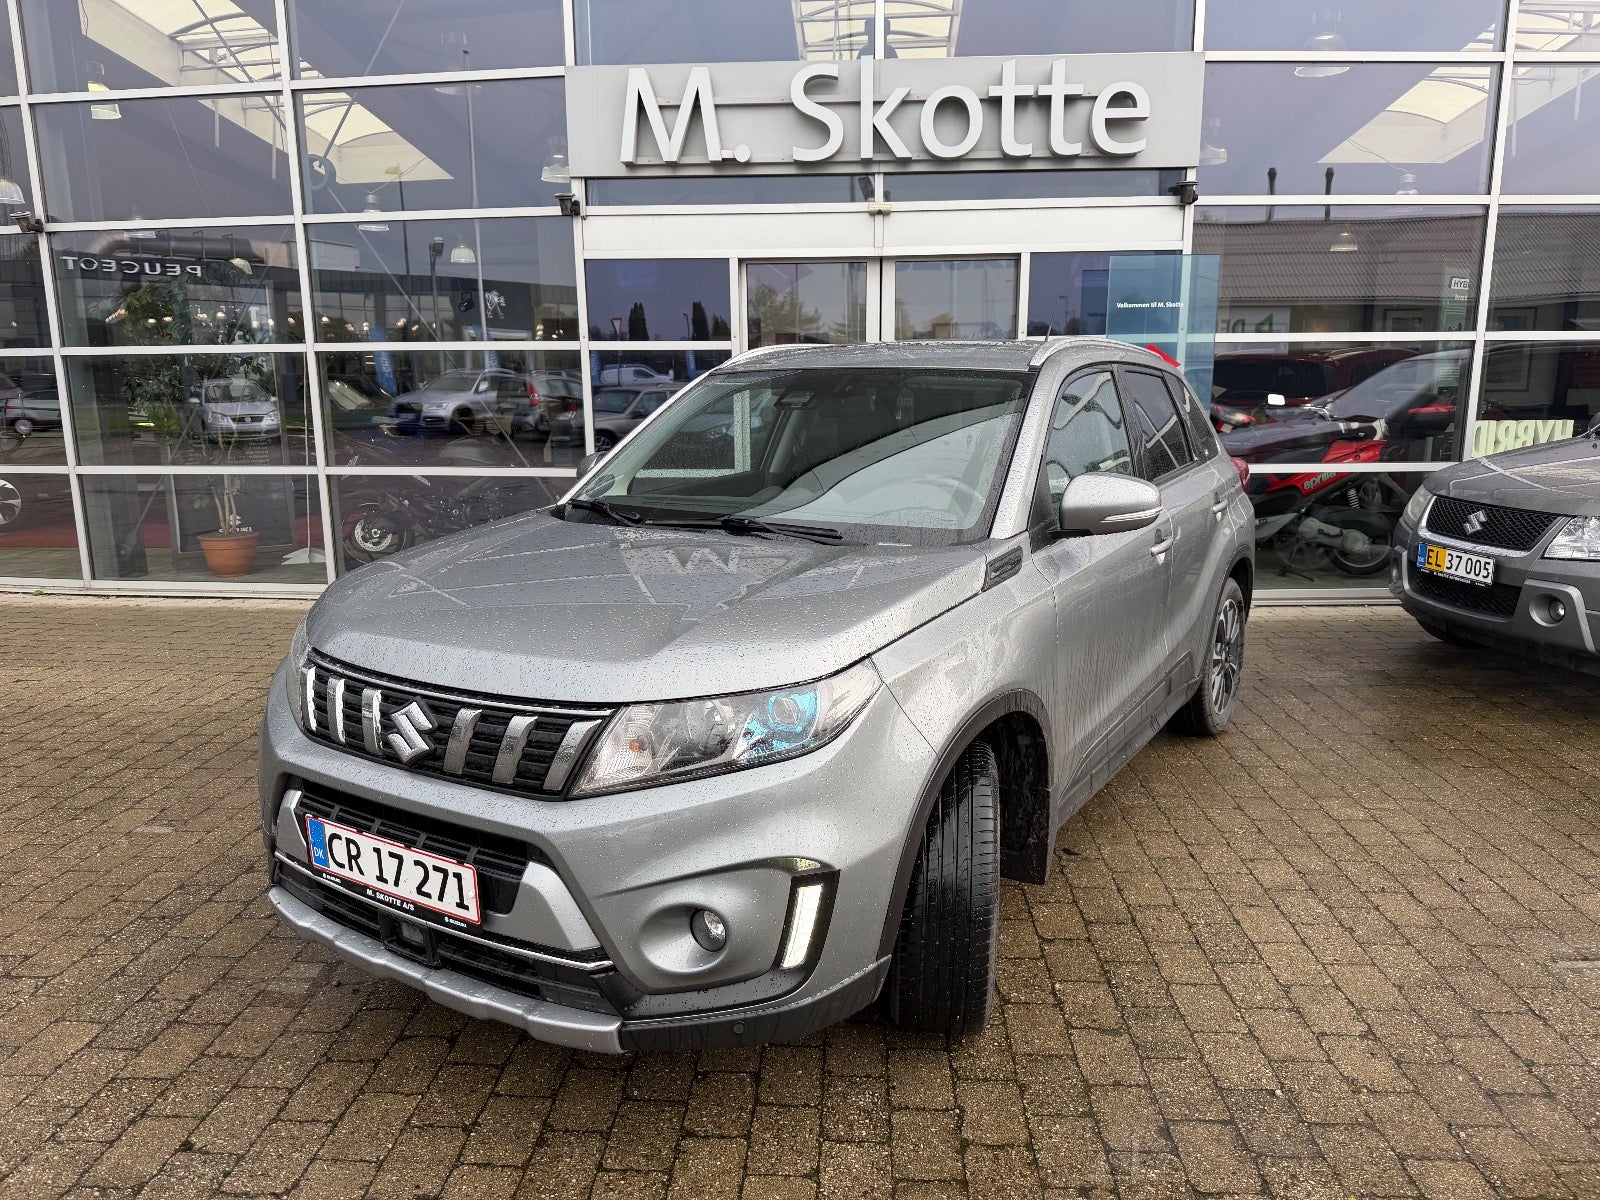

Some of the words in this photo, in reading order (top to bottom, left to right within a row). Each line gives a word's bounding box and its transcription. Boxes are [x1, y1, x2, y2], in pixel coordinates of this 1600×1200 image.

[619, 66, 752, 167] M.
[789, 54, 1151, 163] Skotte
[1427, 549, 1441, 567] EL
[1446, 554, 1462, 571] 37
[1465, 558, 1490, 578] 005
[313, 846, 325, 860] DK
[327, 832, 366, 877] CR
[372, 846, 404, 888] 17
[413, 859, 470, 912] 271
[366, 889, 375, 898] M.
[376, 891, 402, 907] SKOTTE
[402, 902, 415, 911] A/S
